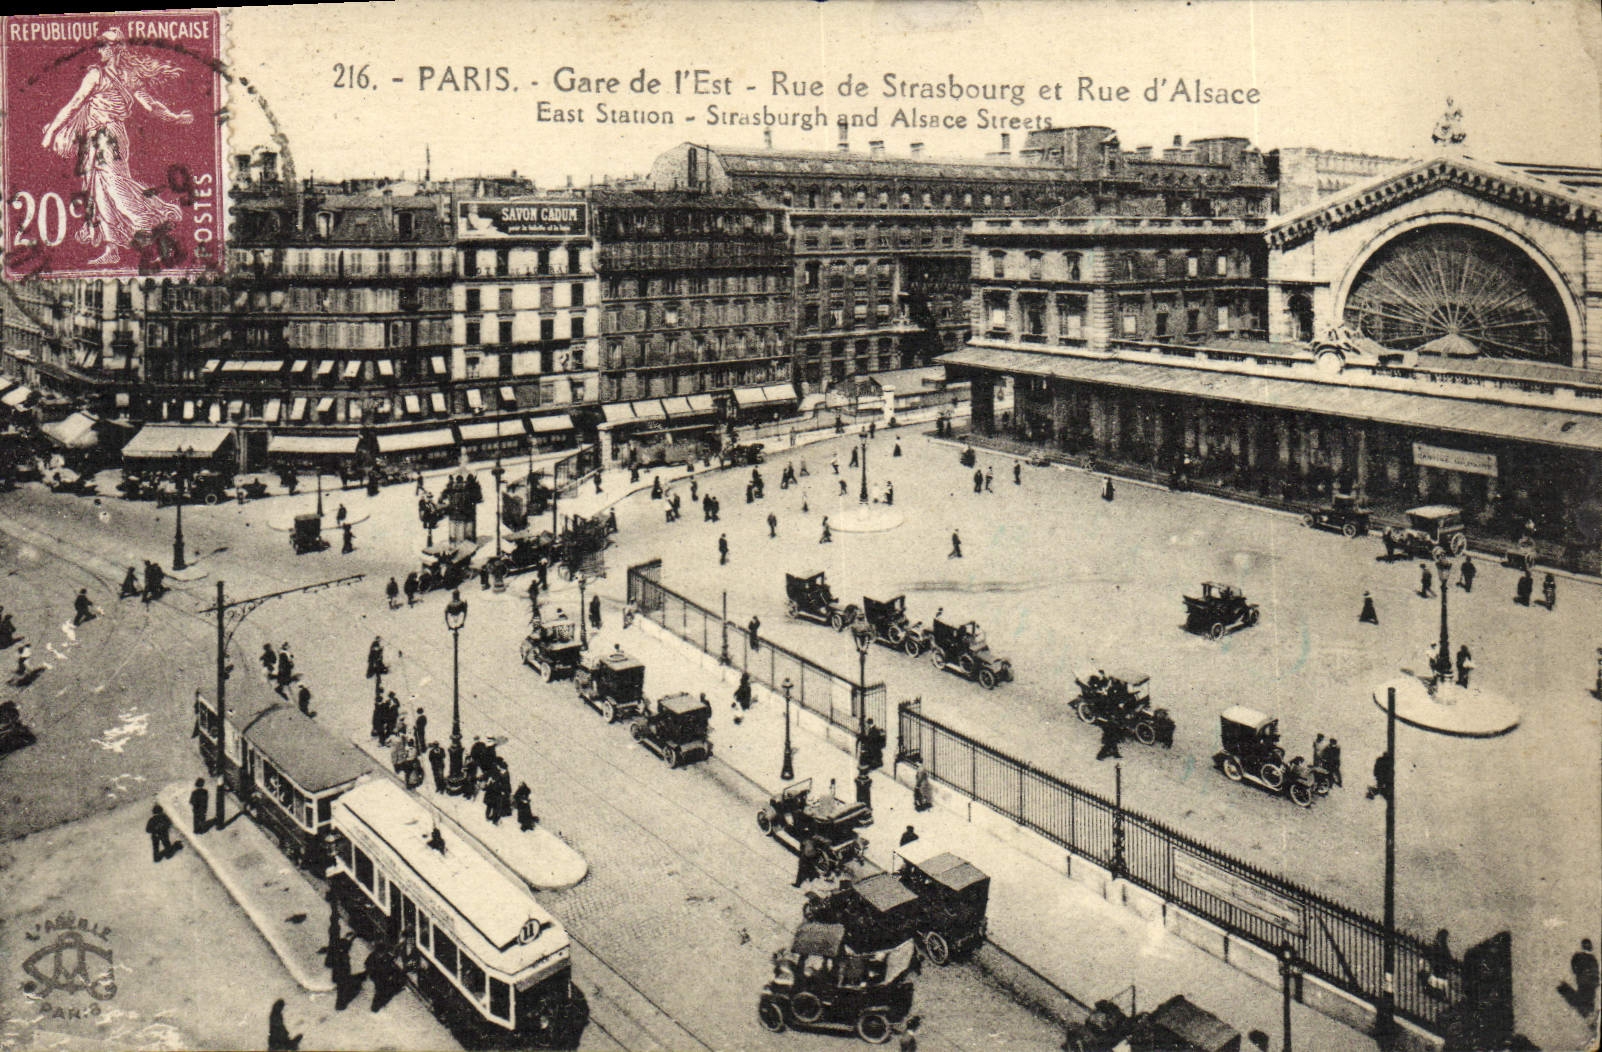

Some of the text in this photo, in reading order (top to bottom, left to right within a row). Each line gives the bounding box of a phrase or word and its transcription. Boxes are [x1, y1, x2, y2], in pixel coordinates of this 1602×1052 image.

[127, 20, 210, 40] FRANÇAISE
[501, 207, 578, 222] SAVON CADUM
